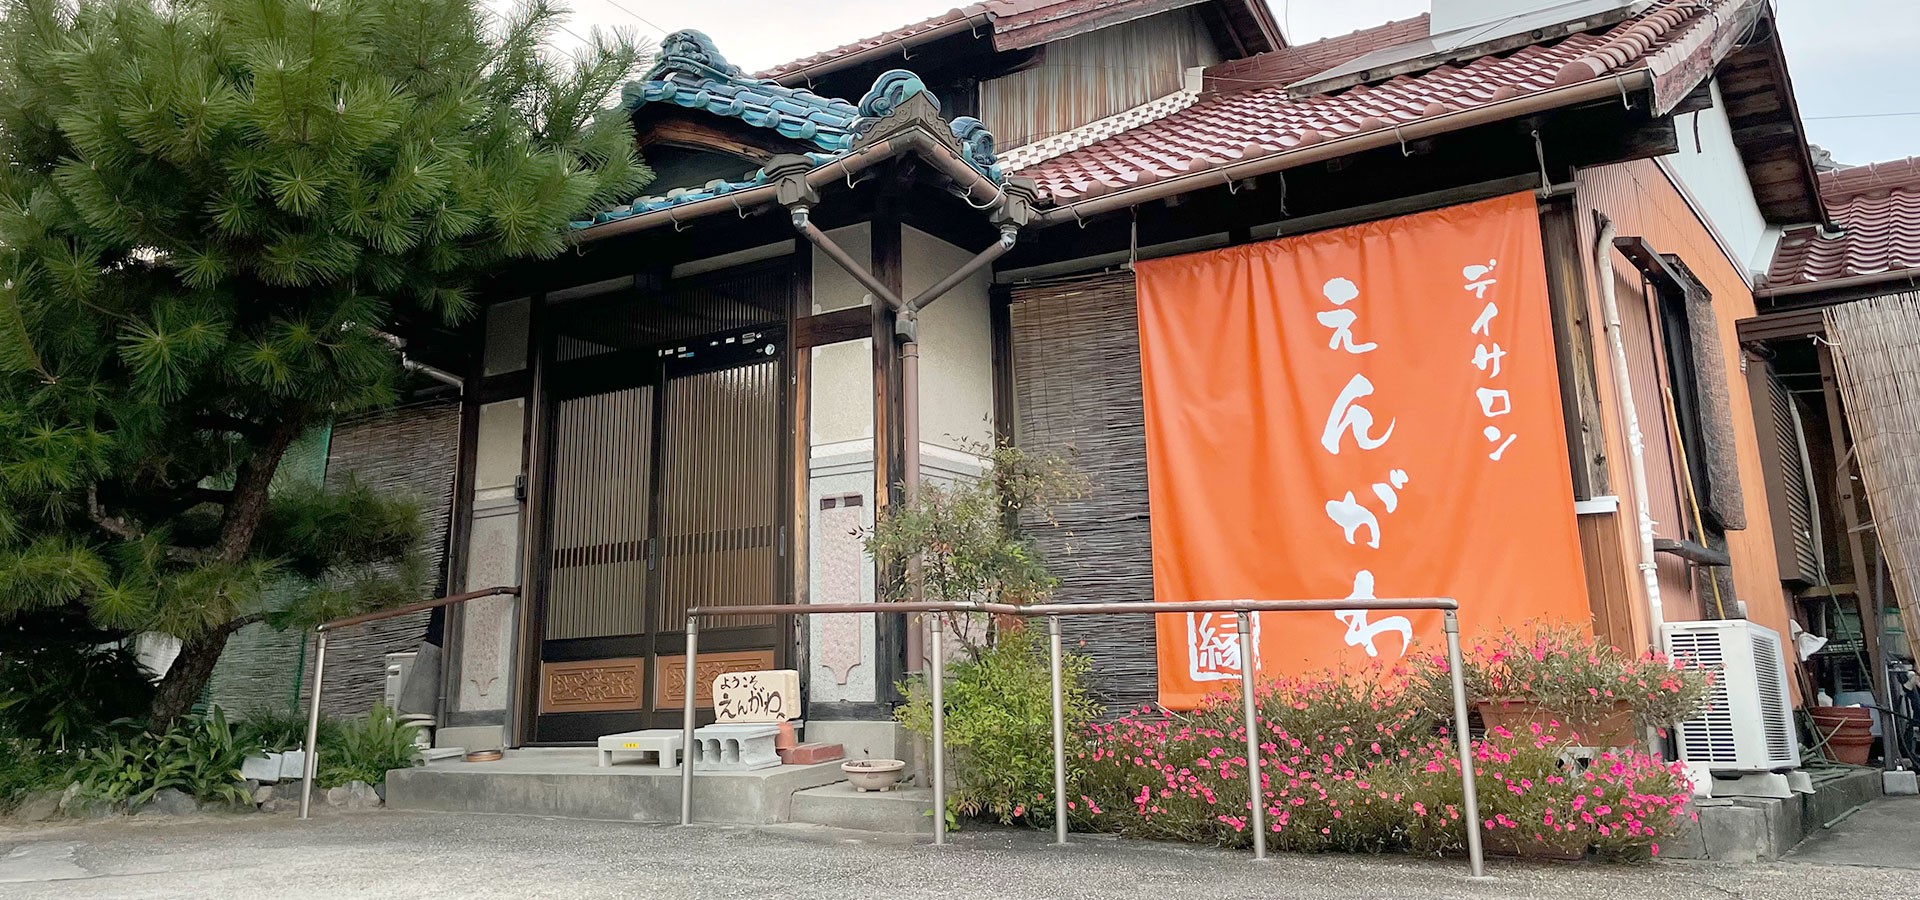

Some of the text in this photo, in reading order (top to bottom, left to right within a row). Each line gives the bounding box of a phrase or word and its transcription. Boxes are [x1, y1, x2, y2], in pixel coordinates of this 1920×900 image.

[1462, 258, 1518, 462] デイサロン
[1316, 276, 1413, 658] えんがわ
[720, 675, 758, 691] ようこそ
